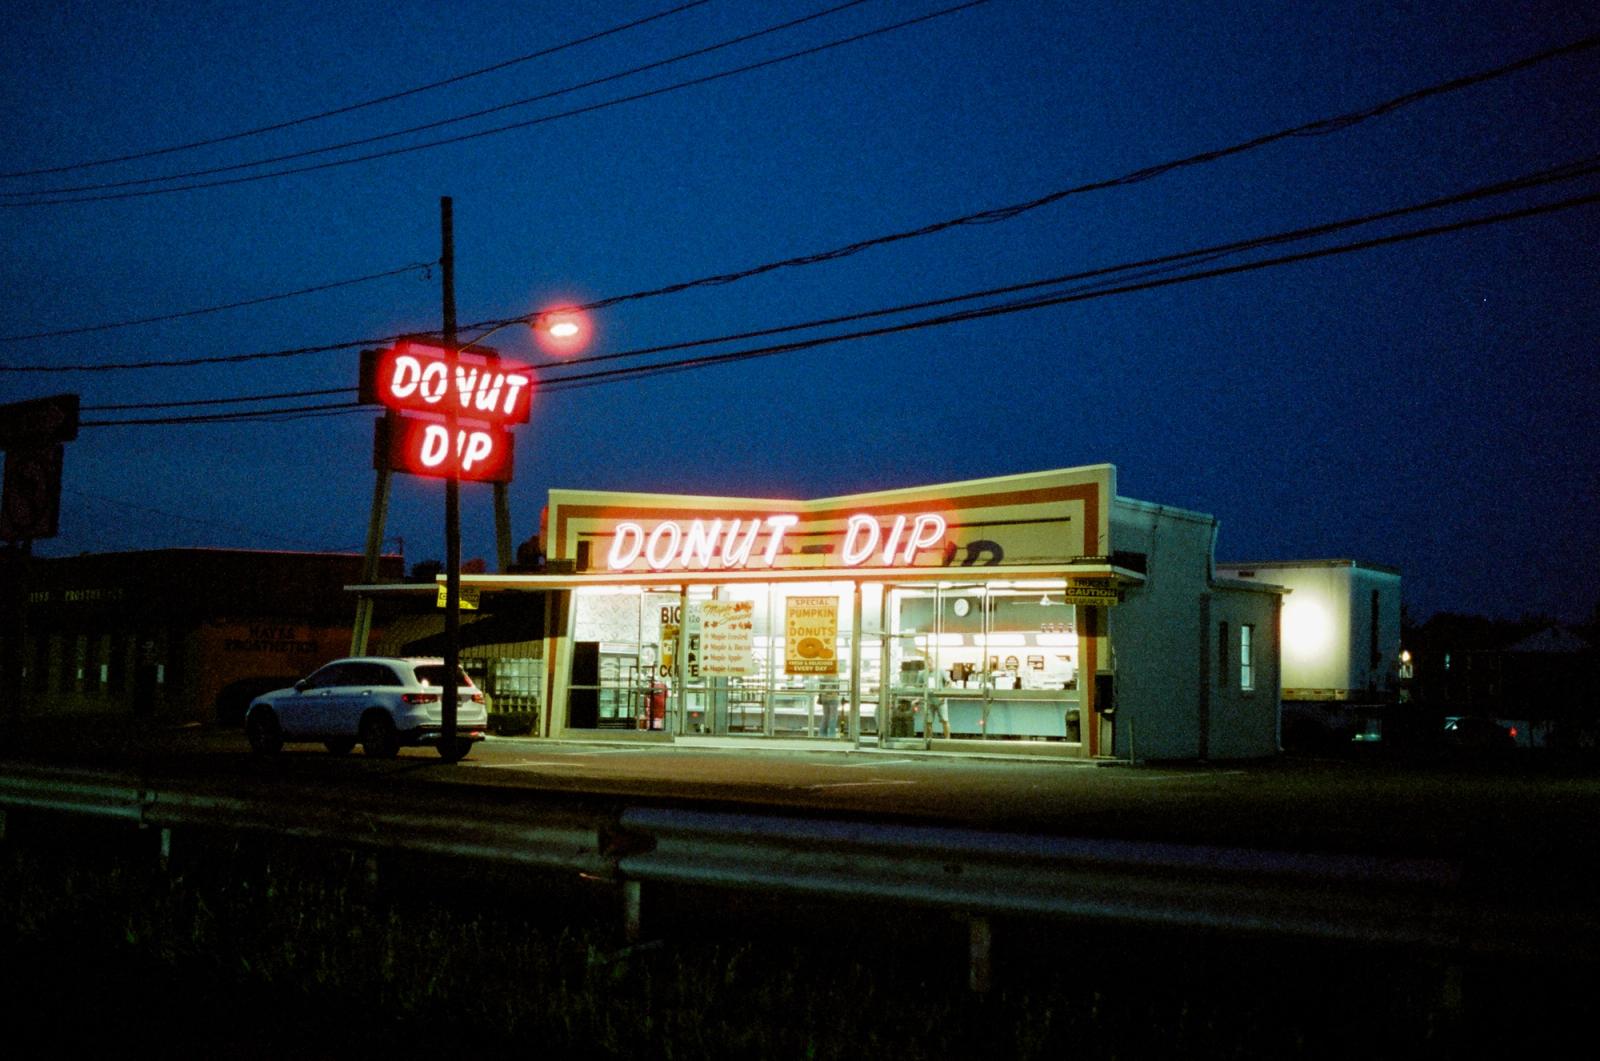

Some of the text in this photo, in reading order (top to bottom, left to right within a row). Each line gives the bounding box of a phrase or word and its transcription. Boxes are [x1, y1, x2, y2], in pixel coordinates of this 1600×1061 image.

[391, 355, 529, 415] DONUT
[420, 424, 493, 472] DIP
[607, 513, 946, 571] DONUT DIP
[1067, 588, 1115, 597] CAUTION
[789, 608, 835, 618] PUMPKIN
[789, 627, 835, 636] DONUTS
